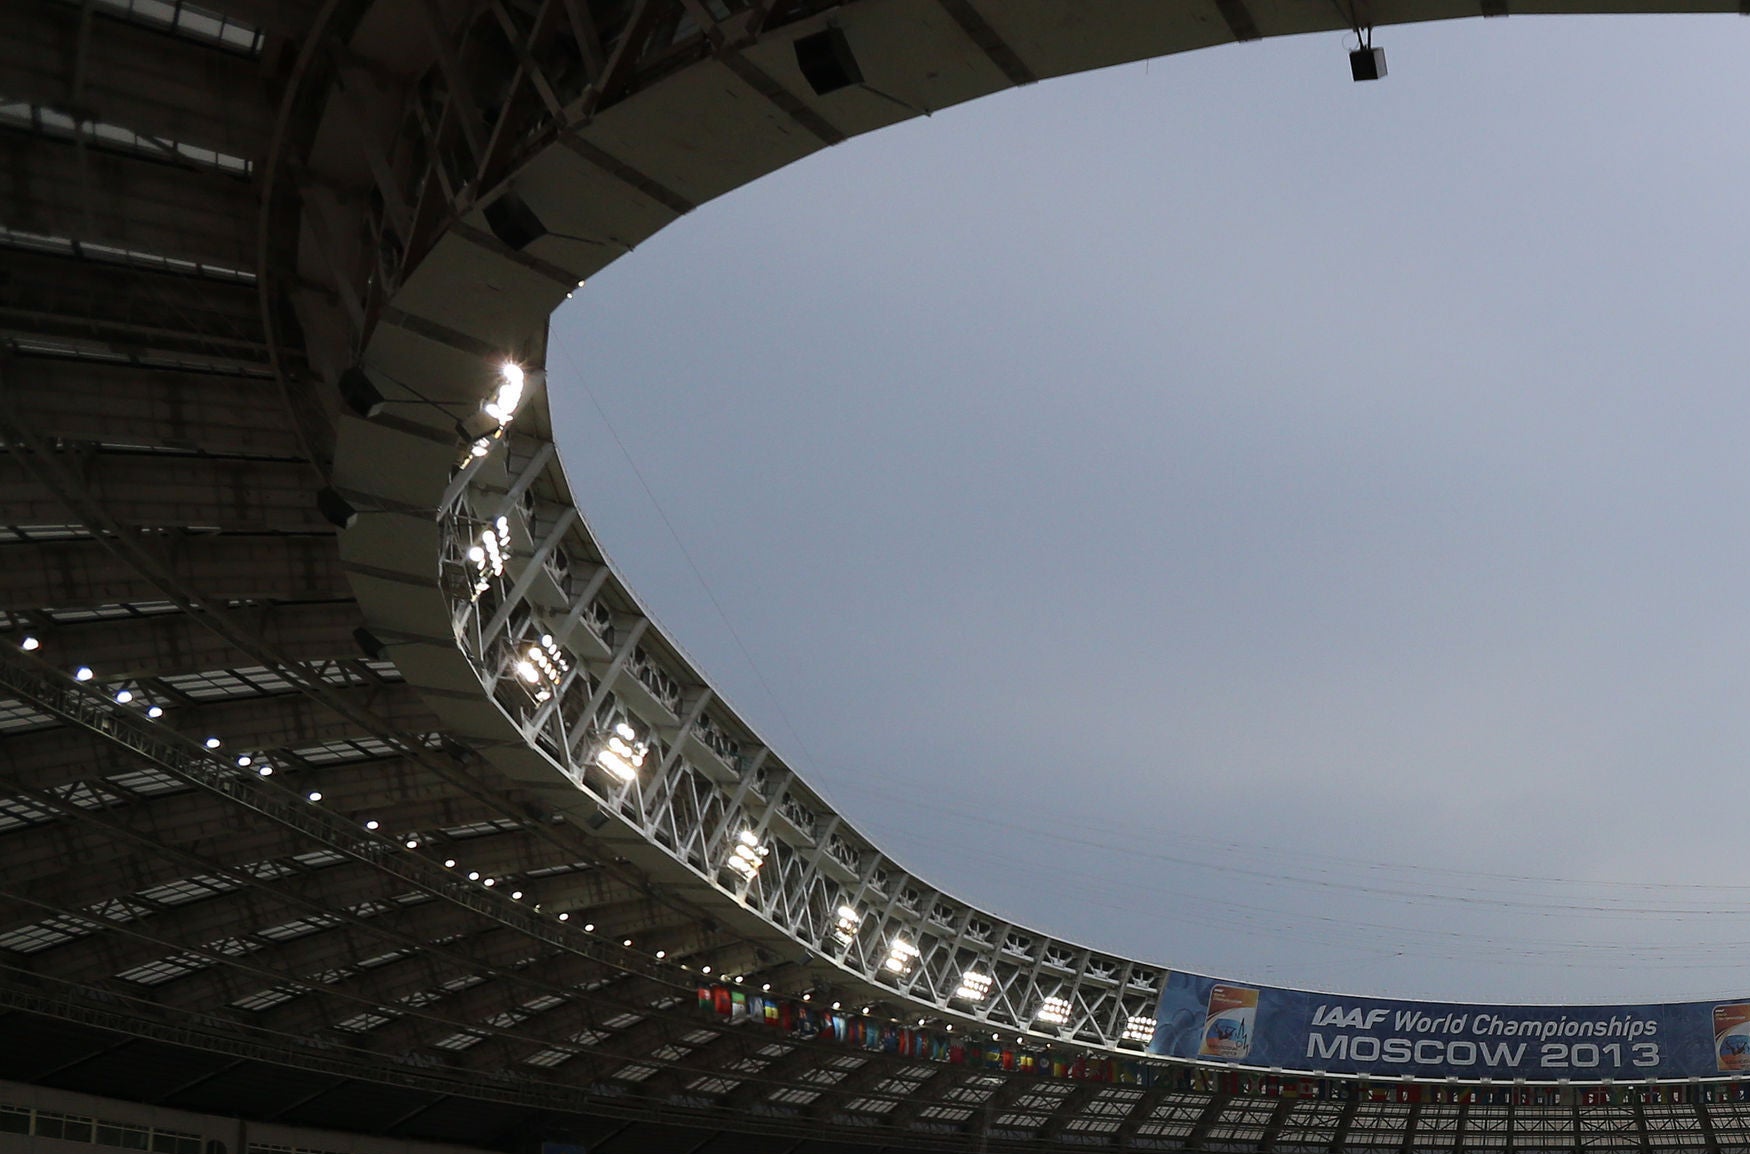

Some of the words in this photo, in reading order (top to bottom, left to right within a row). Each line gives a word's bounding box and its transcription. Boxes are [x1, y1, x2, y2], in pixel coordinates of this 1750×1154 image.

[1311, 1004, 1391, 1031] IAAF
[1394, 1010, 1468, 1035] World
[1471, 1014, 1658, 1041] Championships
[1306, 1032, 1528, 1067] MOSCOW
[1540, 1042, 1661, 1068] 2013
